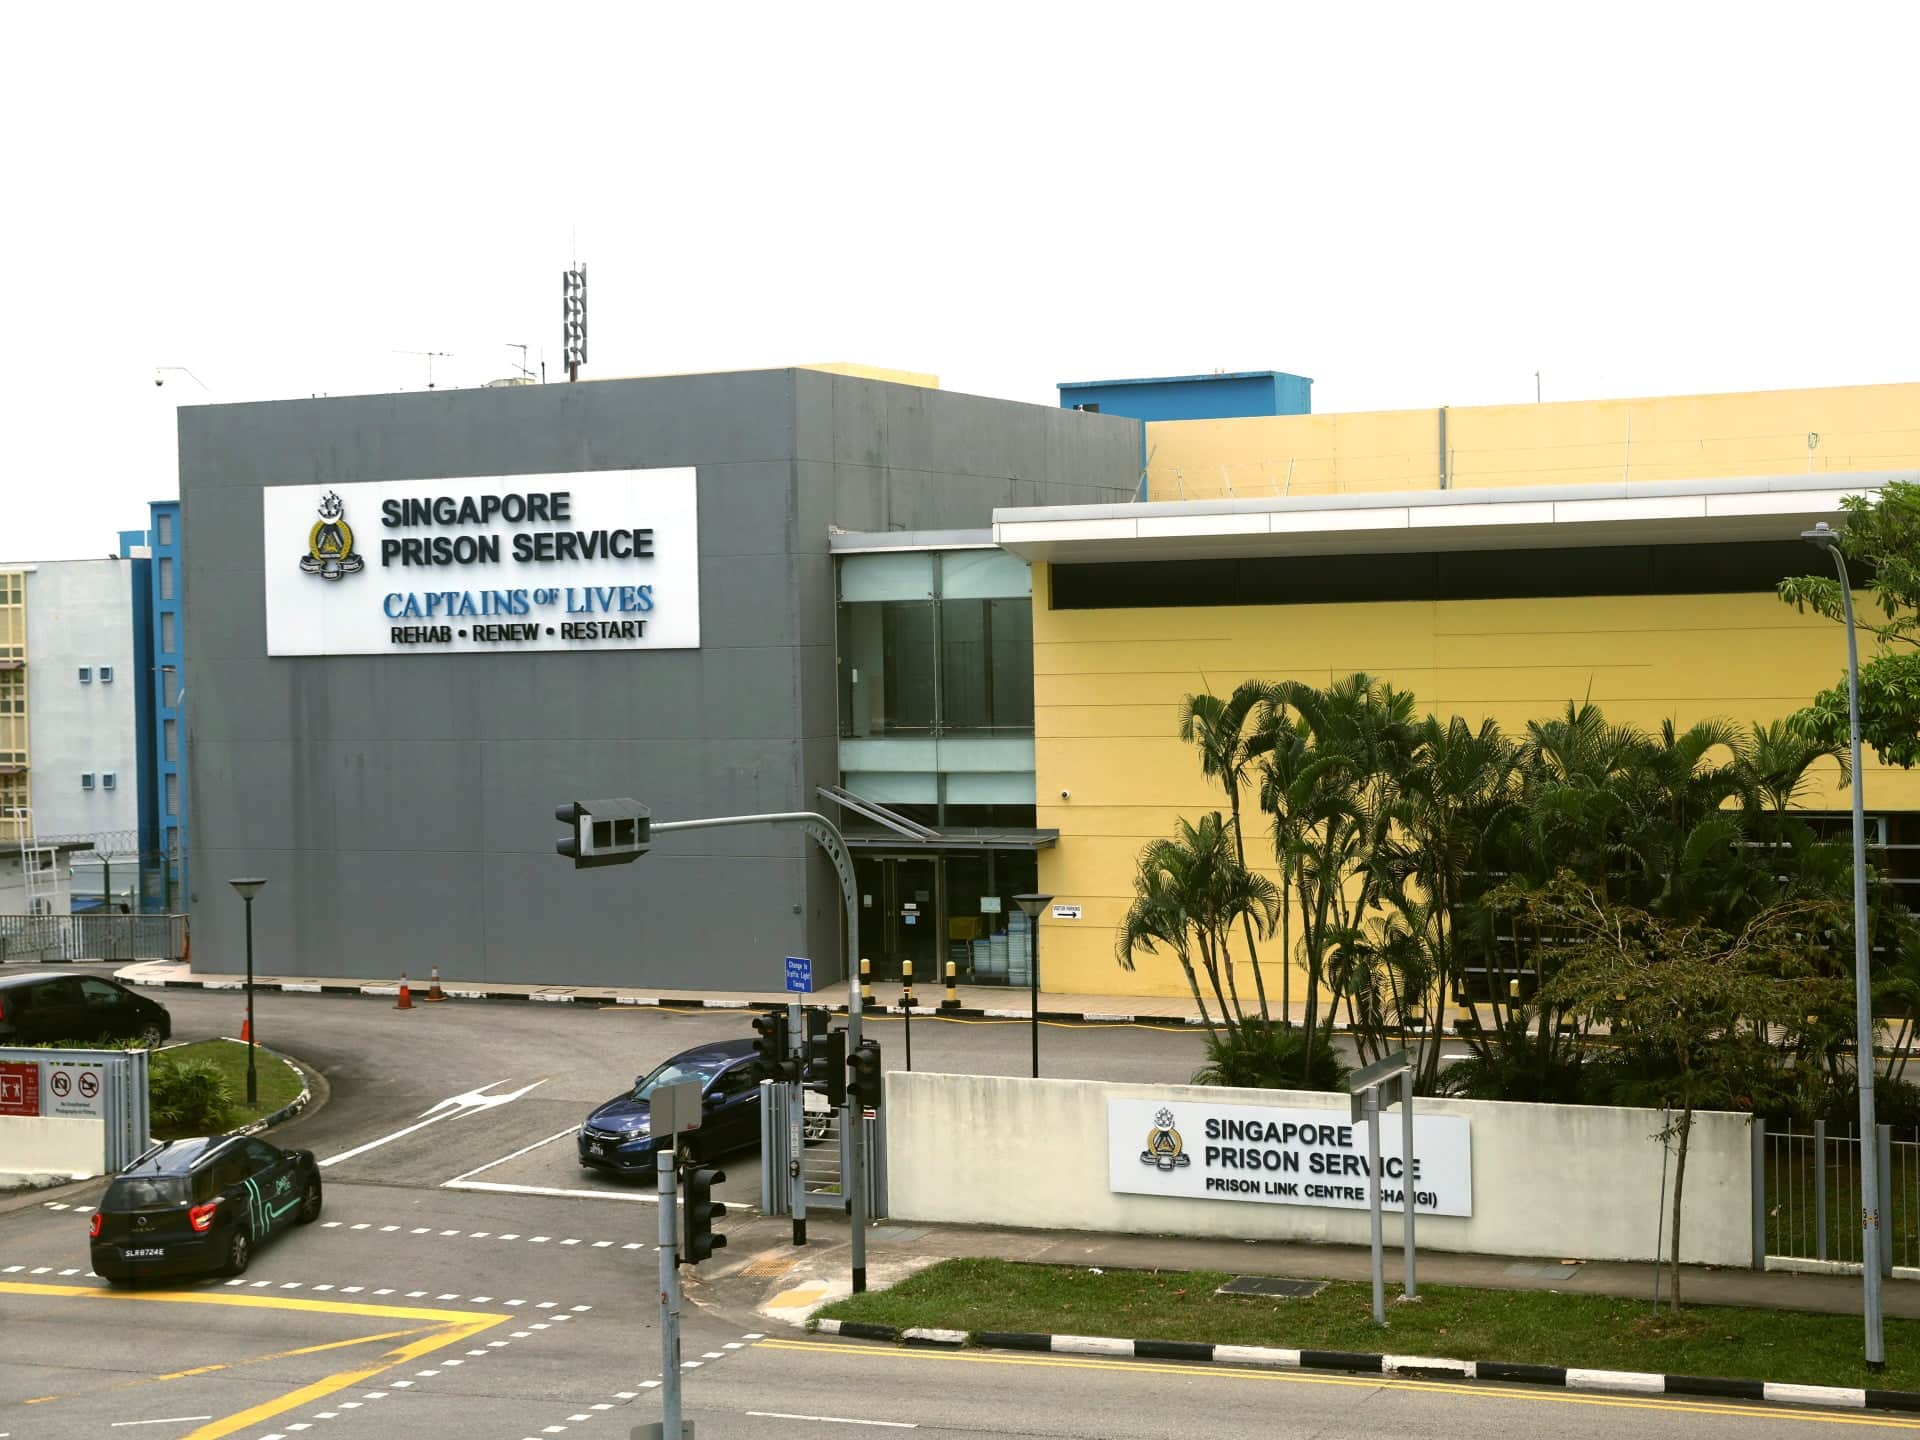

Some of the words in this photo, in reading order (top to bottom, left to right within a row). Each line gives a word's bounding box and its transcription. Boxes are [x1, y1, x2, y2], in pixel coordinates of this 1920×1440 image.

[382, 492, 570, 528] SINGAPORE
[382, 535, 500, 566] PRISON
[512, 529, 654, 562] SERVICE
[383, 589, 530, 618] CAPTAINS
[533, 588, 559, 605] OF
[565, 585, 654, 613] LIVES
[391, 625, 452, 644] REHAB
[473, 623, 539, 642] RENEW
[561, 620, 647, 640] RESTART
[1205, 1119, 1353, 1147] SINGAPORE
[1205, 1146, 1300, 1172] PRISON
[1206, 1177, 1261, 1194] PRISON
[1265, 1182, 1298, 1197] LINK
[1304, 1184, 1365, 1200] CENTRE
